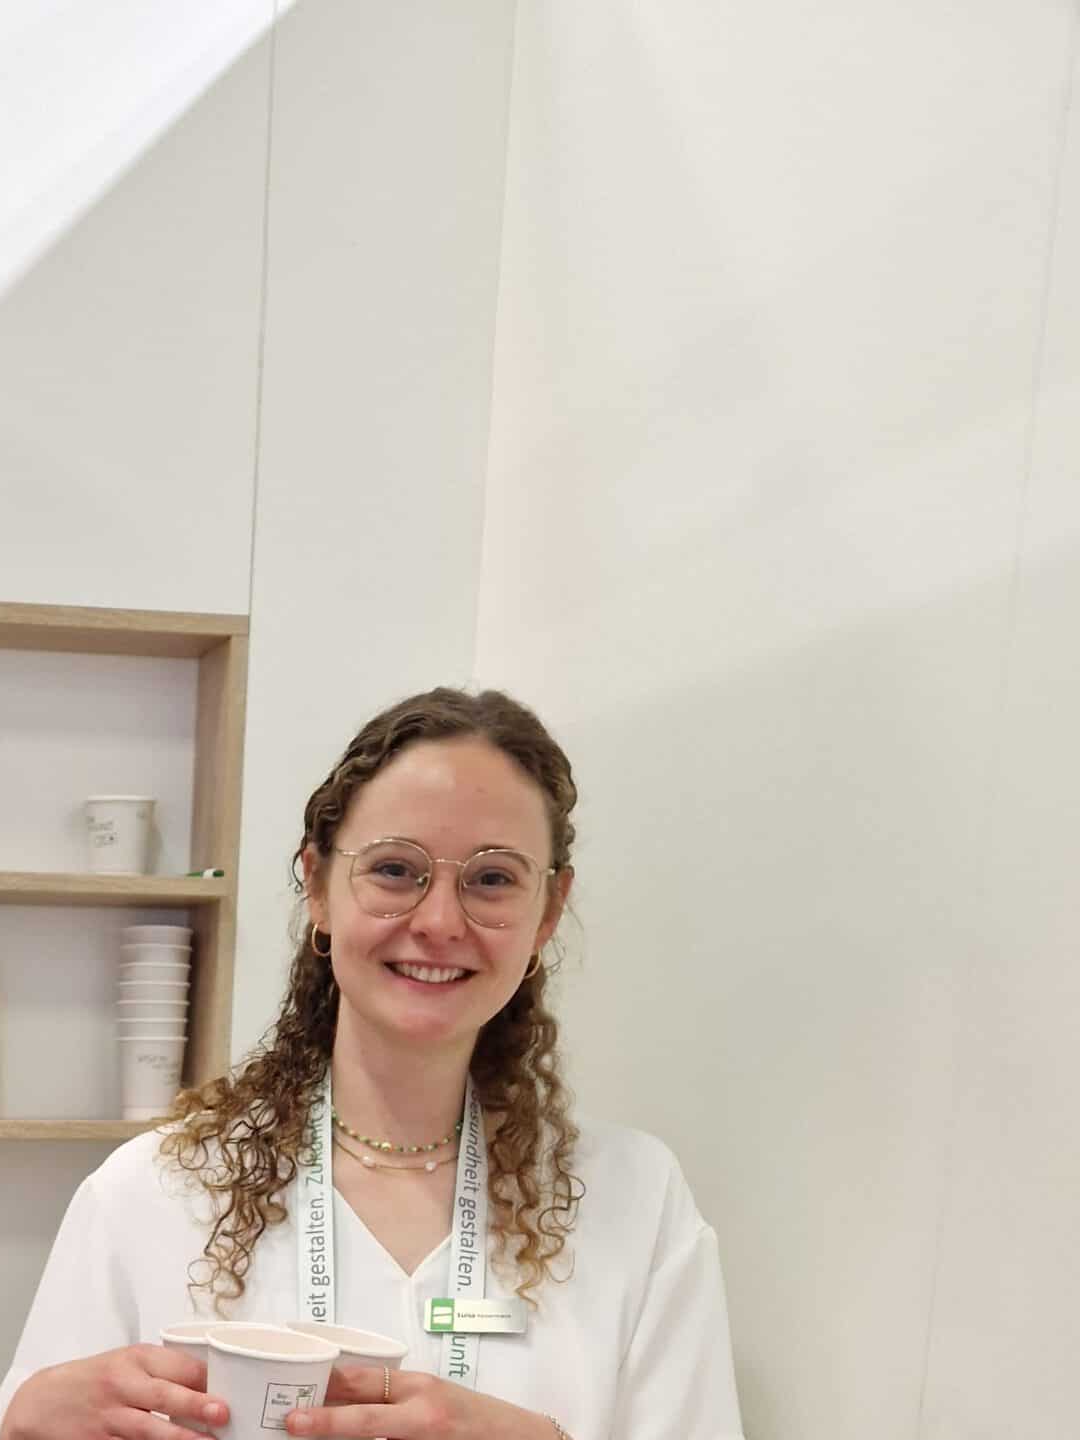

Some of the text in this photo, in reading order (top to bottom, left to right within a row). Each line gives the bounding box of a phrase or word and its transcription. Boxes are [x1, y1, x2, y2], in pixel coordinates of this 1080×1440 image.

[305, 1191, 330, 1287] gestalten.
[457, 1196, 479, 1292] gestalten.
[306, 1293, 326, 1322] eit
[448, 1335, 470, 1378] unft
